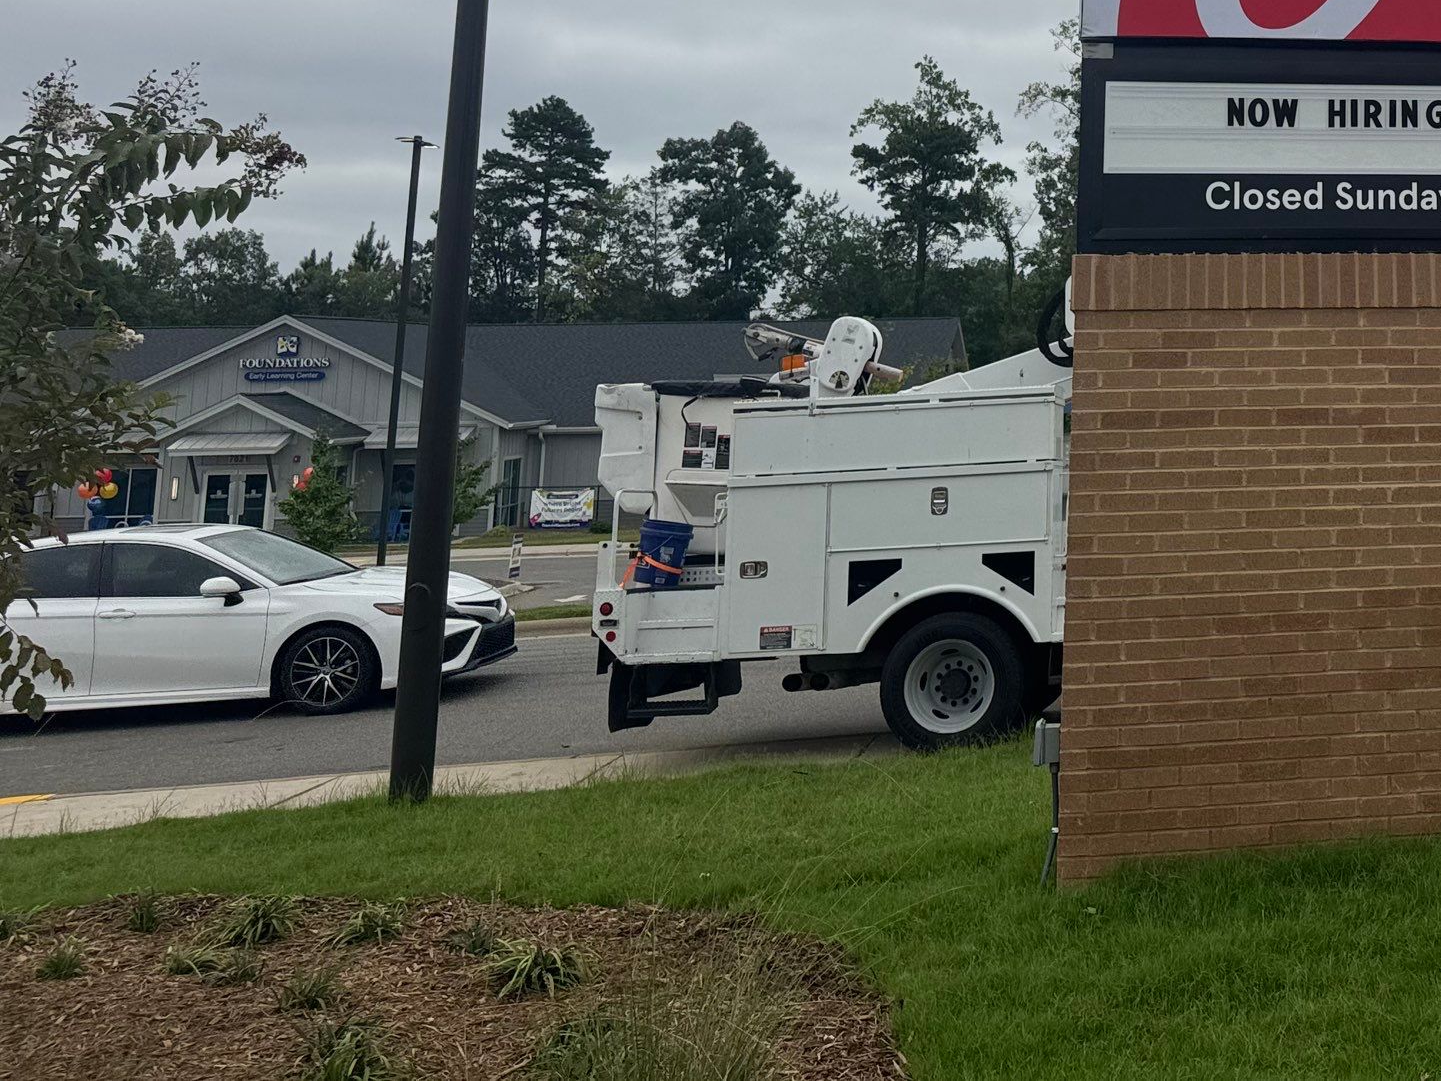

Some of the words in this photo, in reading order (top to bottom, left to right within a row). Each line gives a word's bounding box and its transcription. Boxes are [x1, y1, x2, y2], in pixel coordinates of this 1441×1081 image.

[1227, 97, 1299, 128] NOW
[1205, 181, 1324, 211] Closed
[239, 358, 330, 368] FOUNDATIONS
[249, 372, 265, 380] Early
[266, 372, 294, 380] Learning
